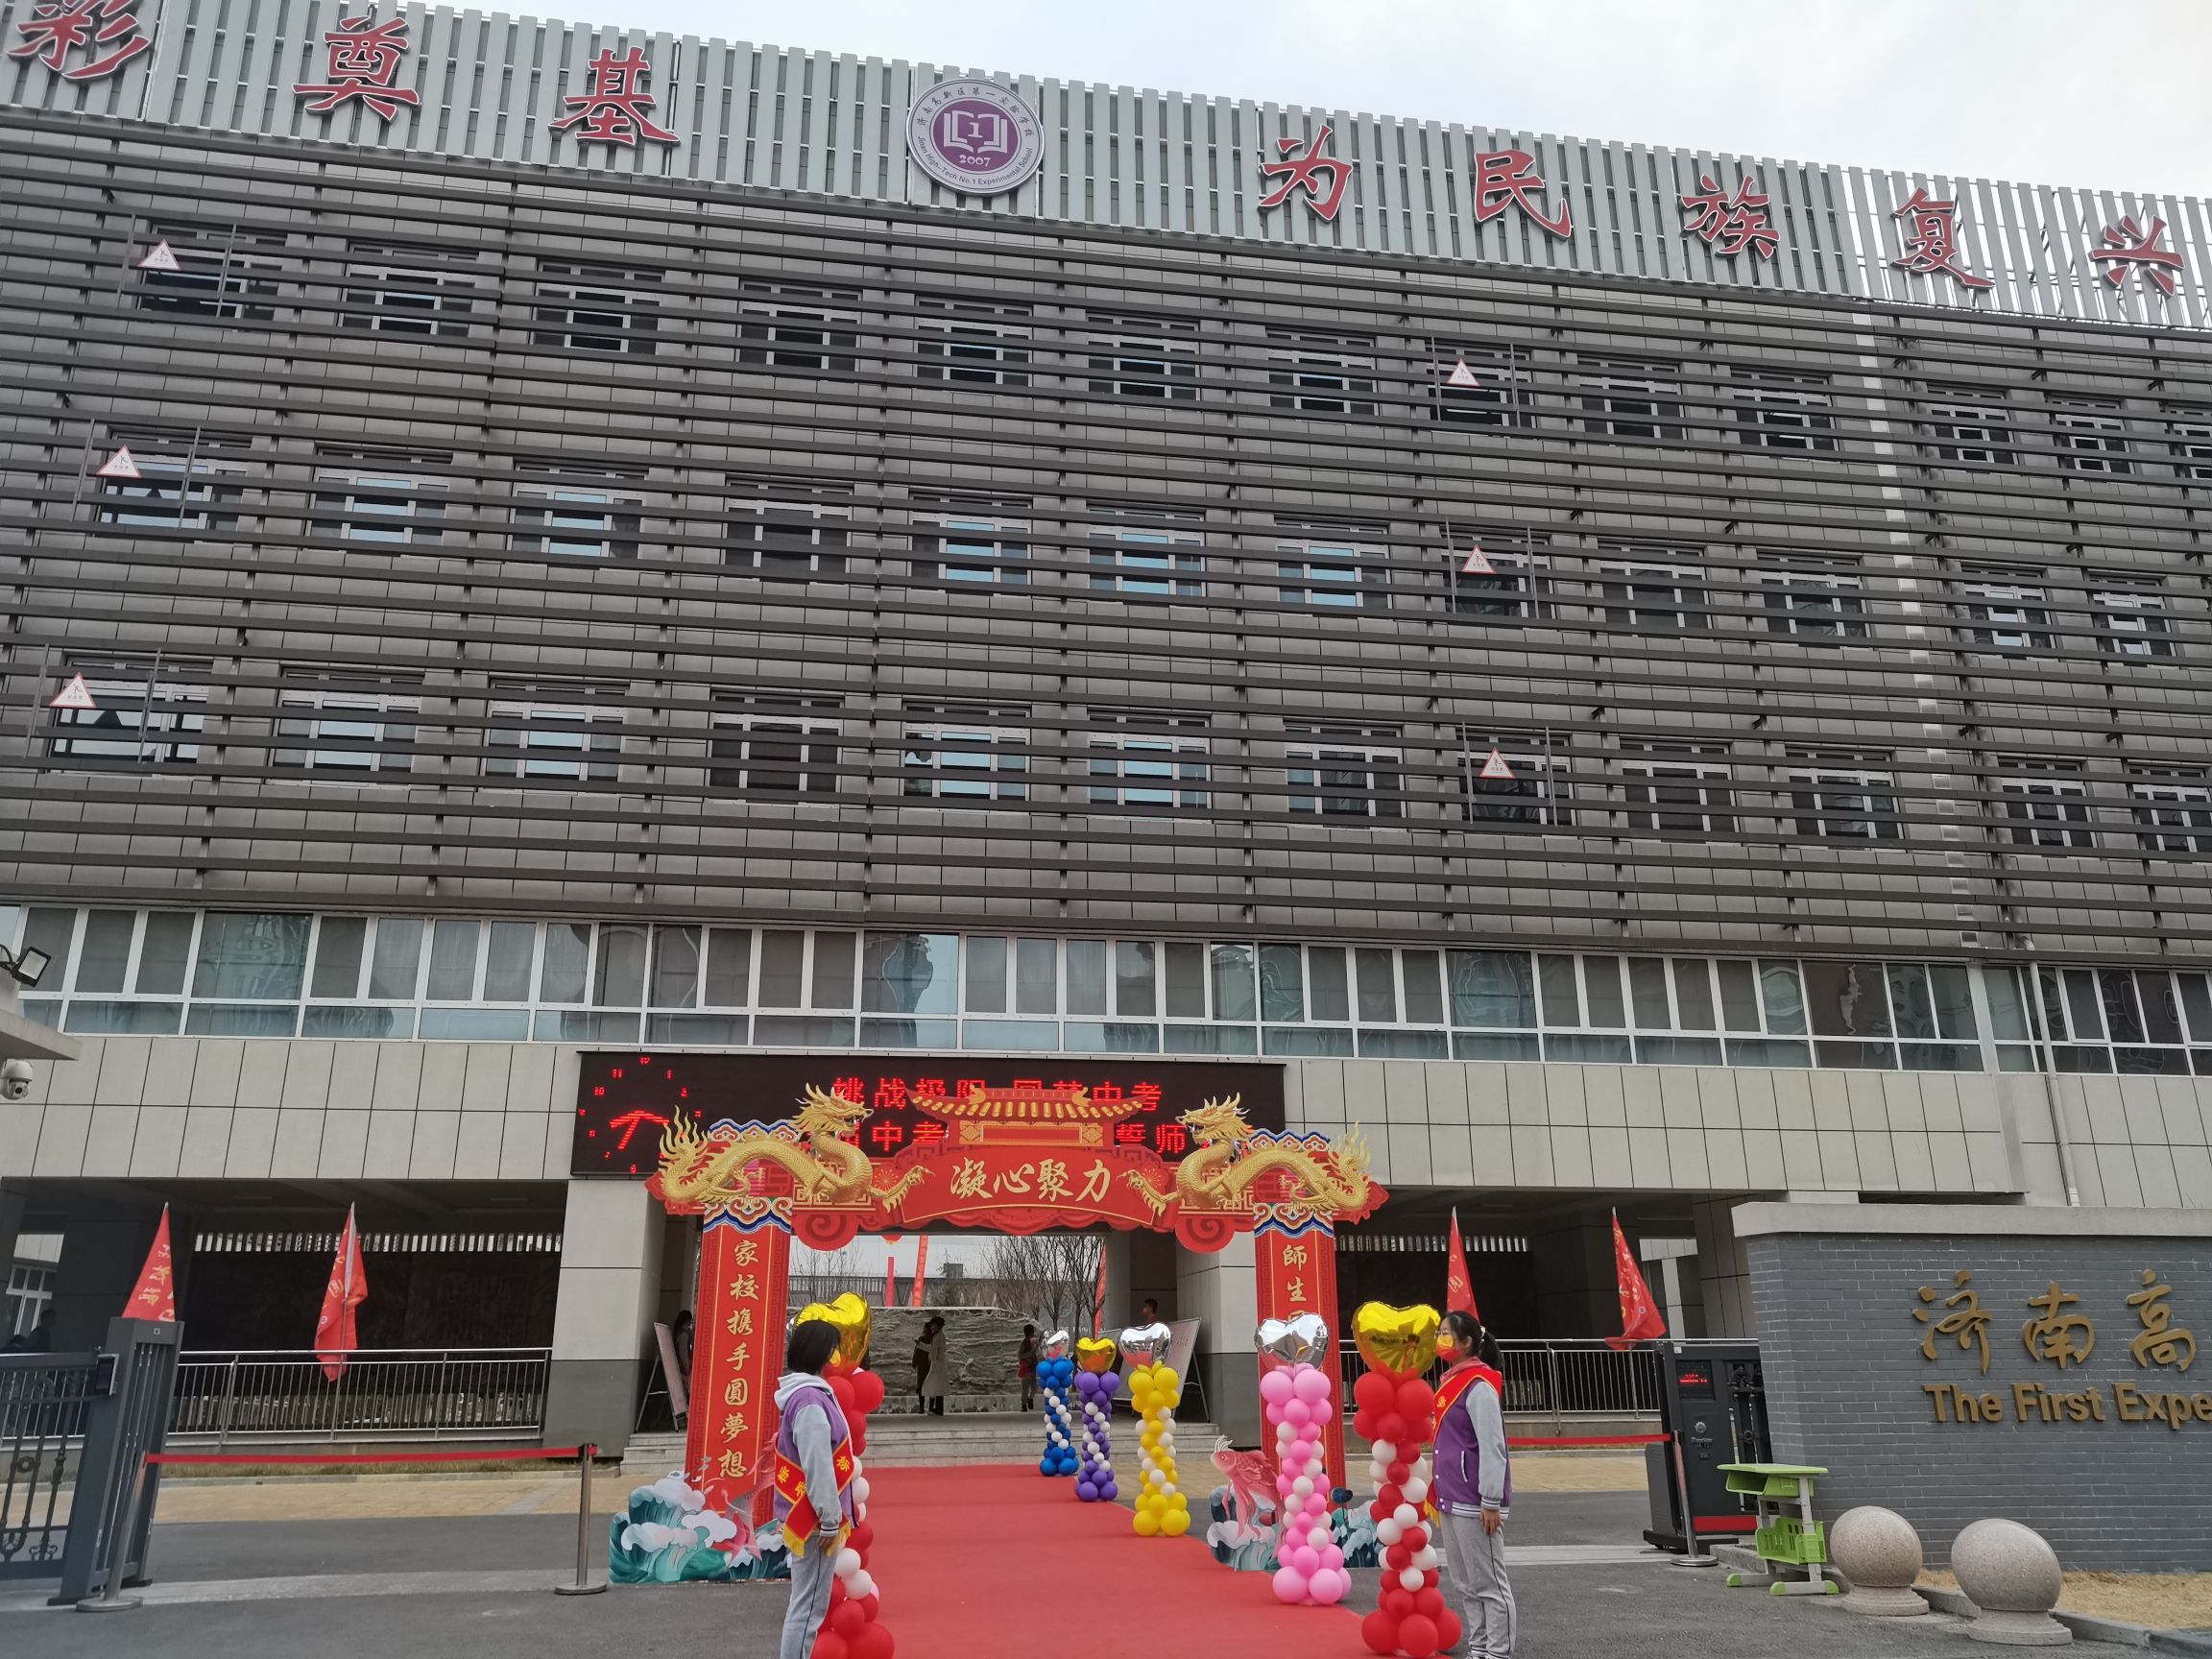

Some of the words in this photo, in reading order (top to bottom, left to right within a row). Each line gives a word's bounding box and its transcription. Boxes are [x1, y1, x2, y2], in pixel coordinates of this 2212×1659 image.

[917, 135, 928, 156] Jinan
[977, 165, 1022, 186] Experimental
[1018, 147, 1034, 168] School
[959, 154, 992, 167] 2007
[1260, 124, 2186, 299] 为民族复兴
[950, 1156, 1112, 1204] 凝心聚力
[1922, 1382, 2005, 1423] The
[2010, 1382, 2106, 1423] First
